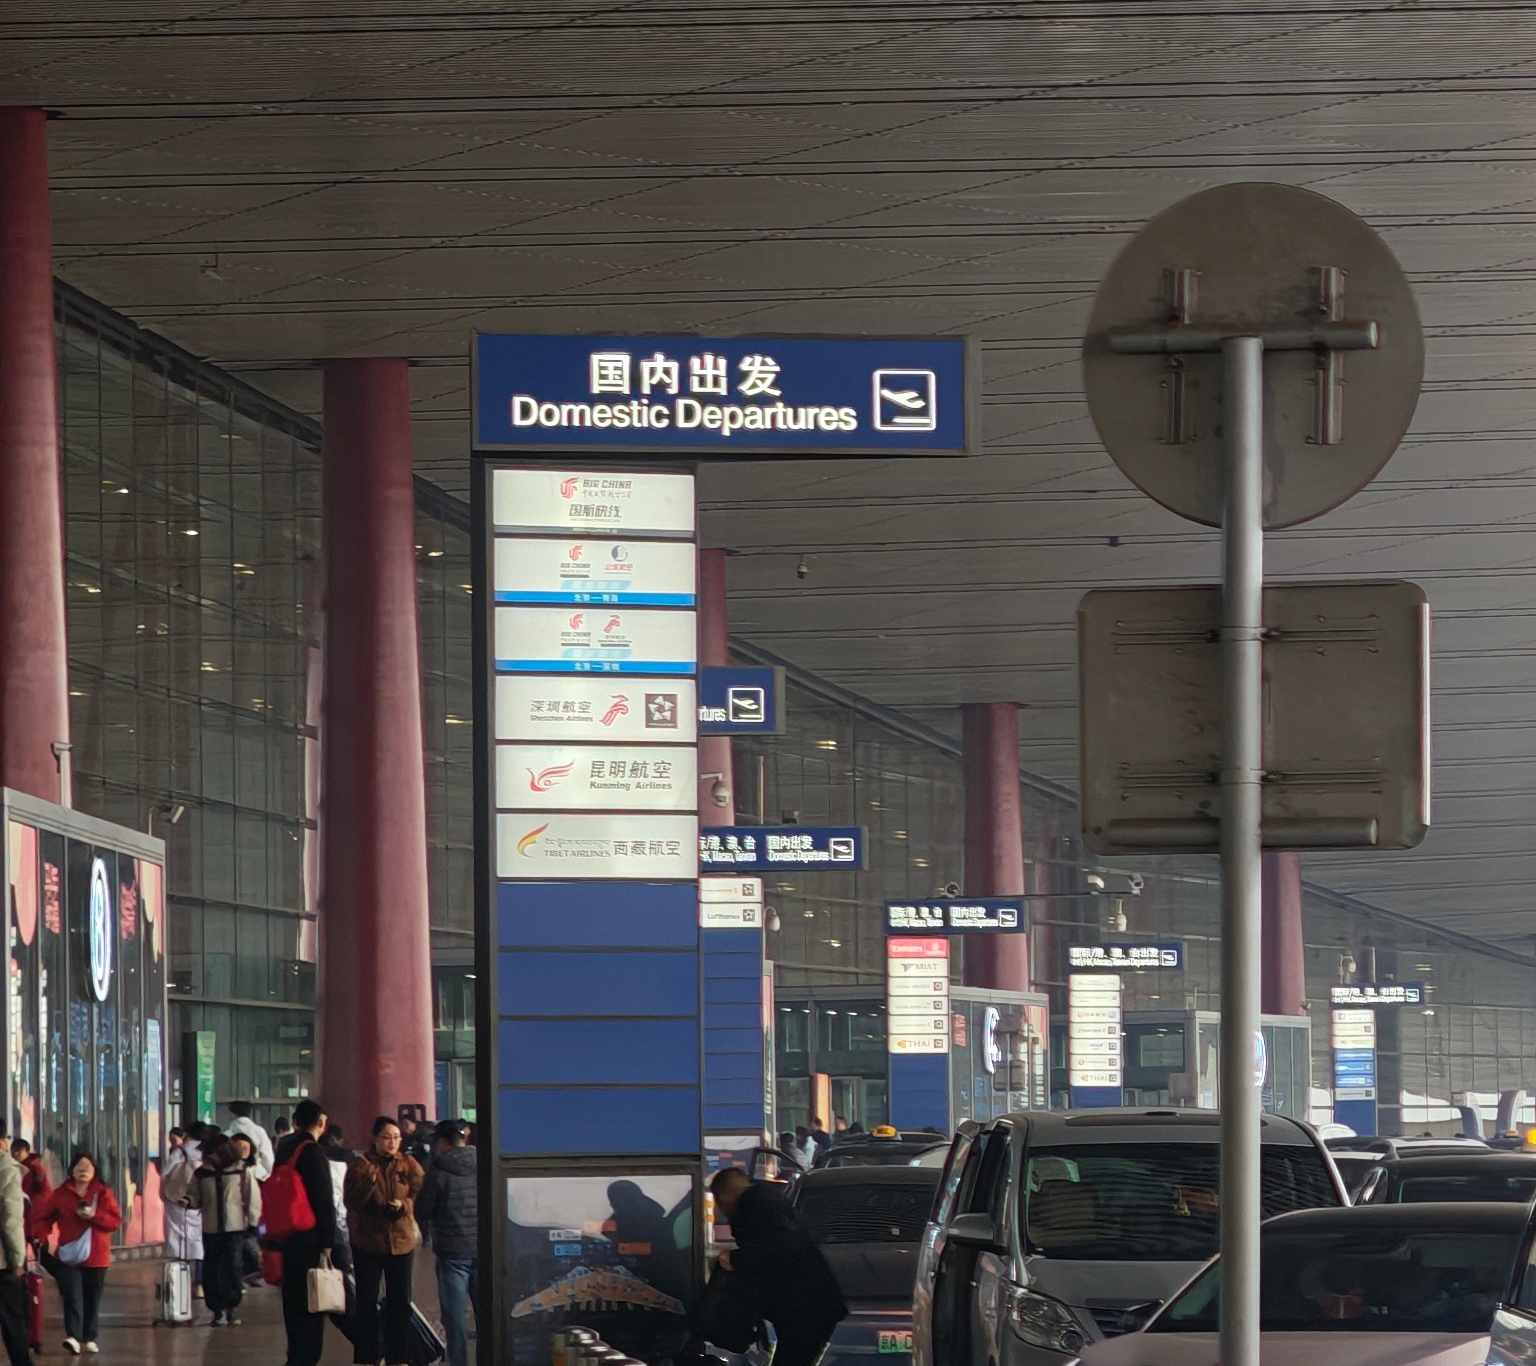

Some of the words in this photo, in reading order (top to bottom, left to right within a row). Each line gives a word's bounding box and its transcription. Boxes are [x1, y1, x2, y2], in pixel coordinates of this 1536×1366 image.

[589, 351, 782, 397] 国内出发
[511, 395, 669, 429] Domestic
[675, 398, 858, 436] Departures
[582, 478, 600, 489] AIR
[602, 479, 632, 490] CHINA
[530, 700, 592, 714] 深圳航空
[589, 760, 673, 779] 昆明航空
[589, 781, 631, 791] Kunming
[635, 781, 673, 790] Airlines
[612, 840, 682, 858] 西藏航空
[908, 1040, 931, 1048] THAI
[1090, 1074, 1108, 1082] THAI
